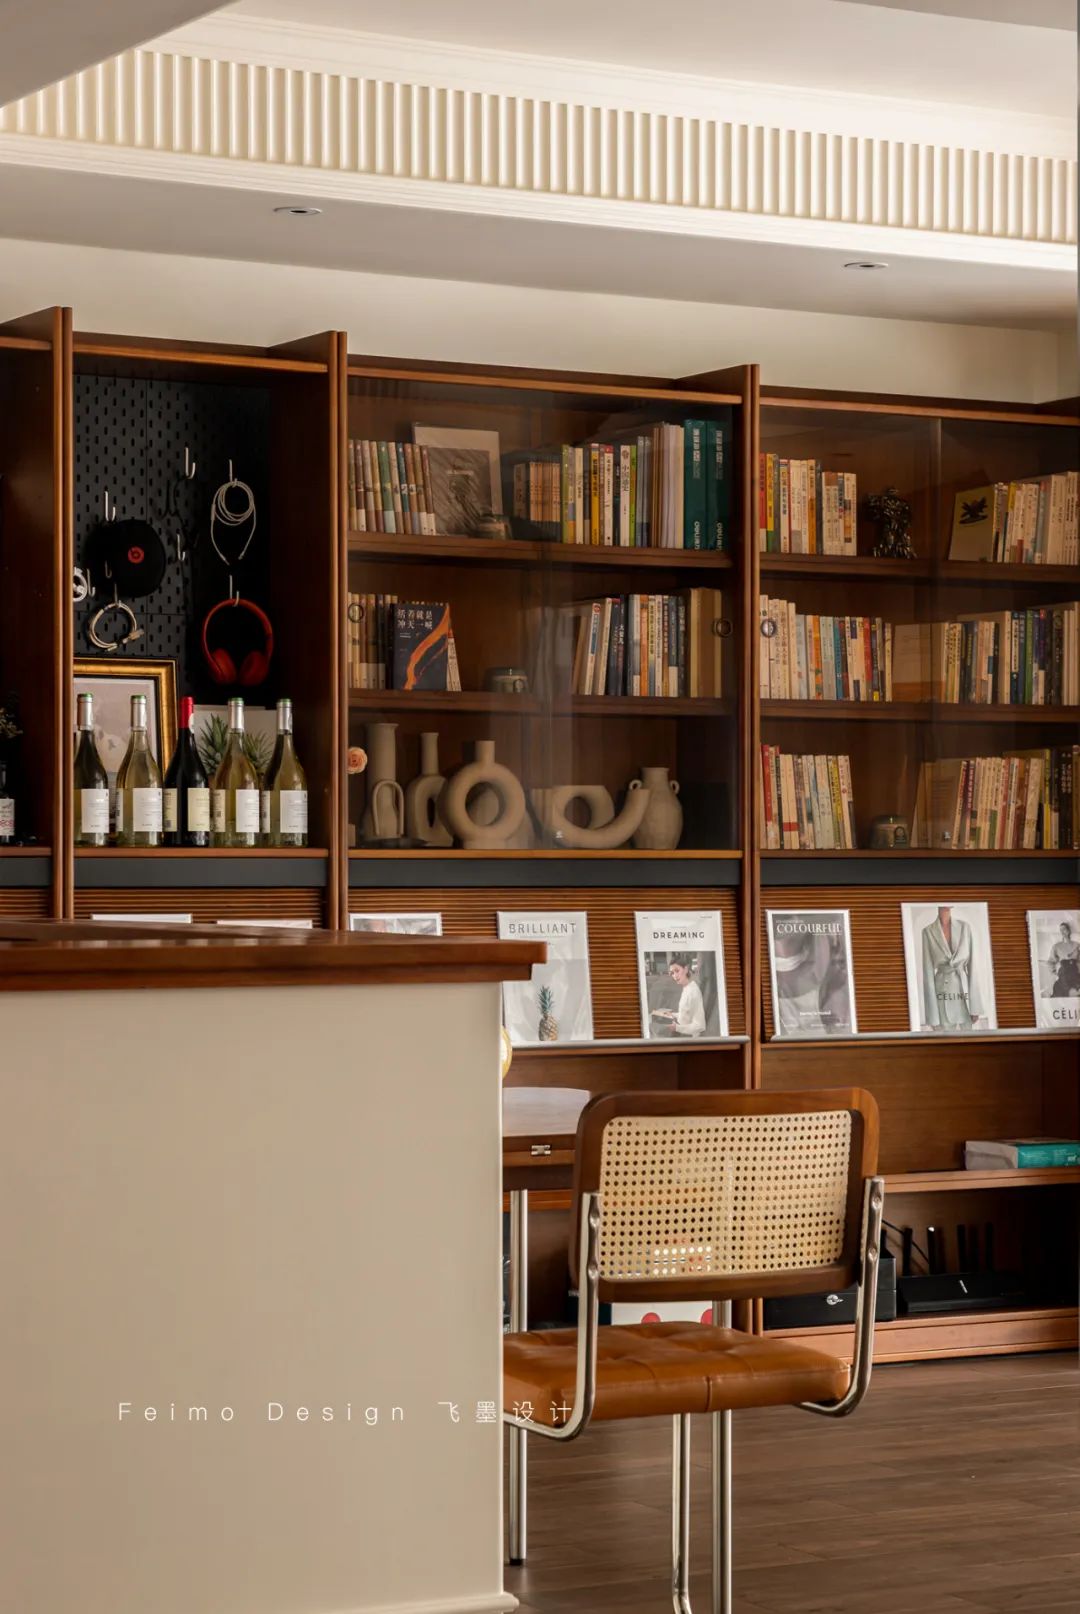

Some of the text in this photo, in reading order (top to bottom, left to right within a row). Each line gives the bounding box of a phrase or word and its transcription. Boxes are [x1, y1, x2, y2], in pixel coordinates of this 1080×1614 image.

[508, 923, 577, 934] BRILLIANT
[776, 923, 842, 934] COLOURFUL
[652, 931, 705, 939] DREAMING
